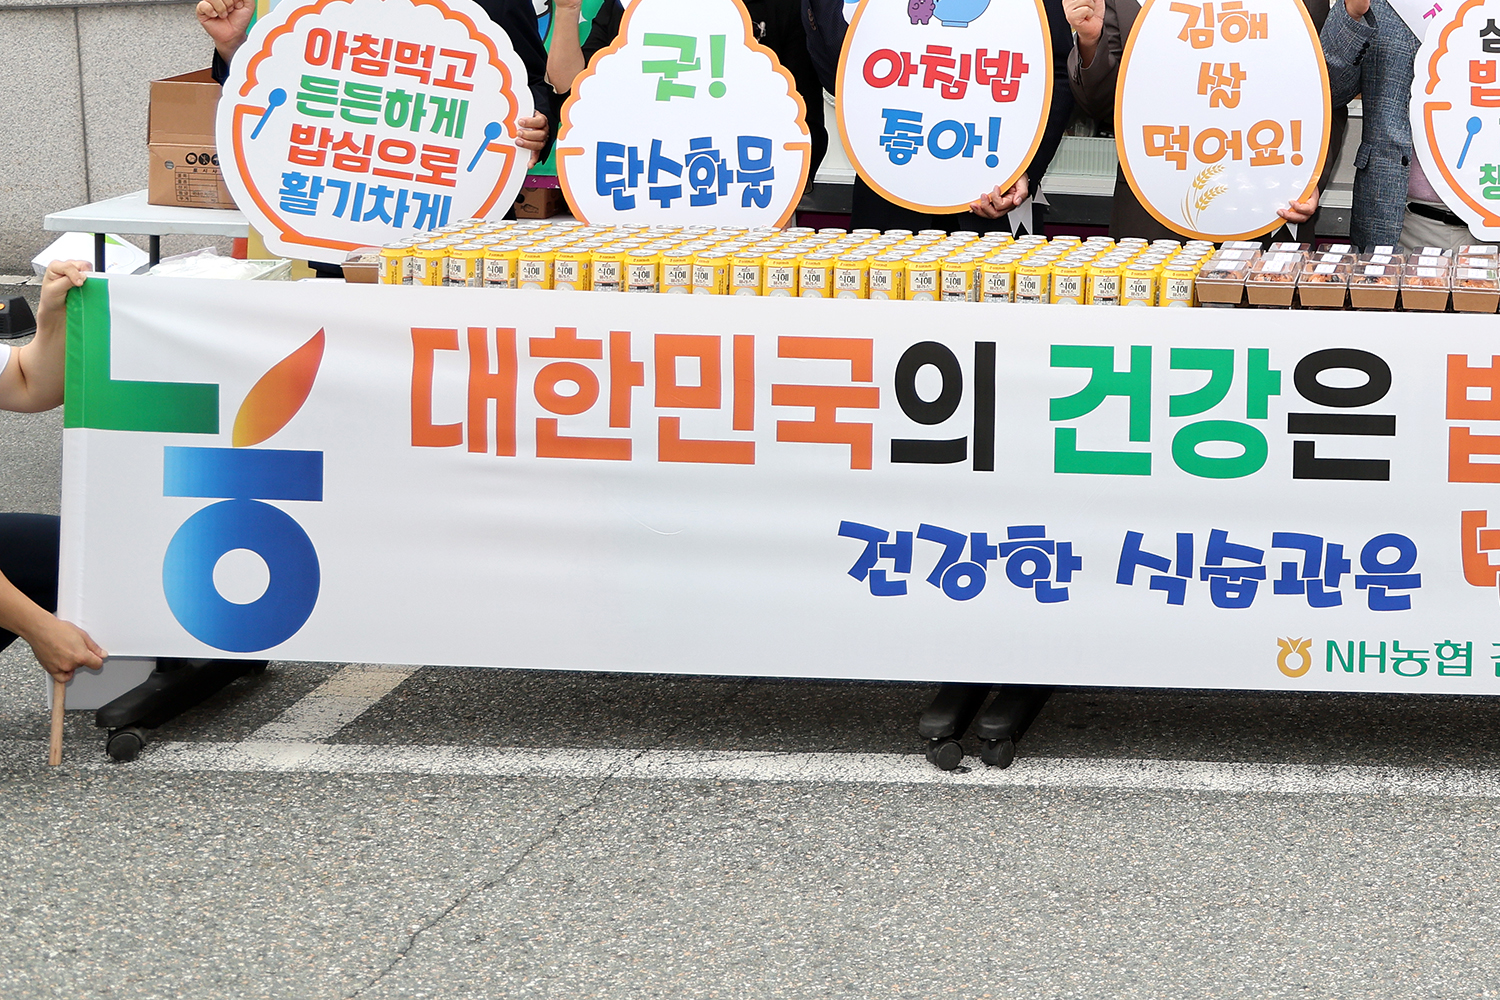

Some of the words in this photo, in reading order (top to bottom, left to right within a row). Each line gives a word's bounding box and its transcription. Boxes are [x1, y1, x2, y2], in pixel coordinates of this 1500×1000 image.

[1170, 1, 1268, 49] 김해
[304, 27, 477, 92] 아침먹고
[863, 44, 1030, 103] 아침밥
[1197, 62, 1247, 109] 쌀
[296, 75, 469, 139] 든든하게
[879, 108, 1003, 168] 좋아!
[288, 123, 460, 188] 밥심으로
[596, 135, 774, 211] 탄수화물
[1142, 120, 1304, 171] 먹어요!
[279, 170, 452, 232] 활기차게
[410, 326, 996, 474] 대한민국의
[1048, 344, 1397, 482] 건강은
[1116, 529, 1422, 612] 식습관은
[1325, 638, 1473, 678] NH농협
